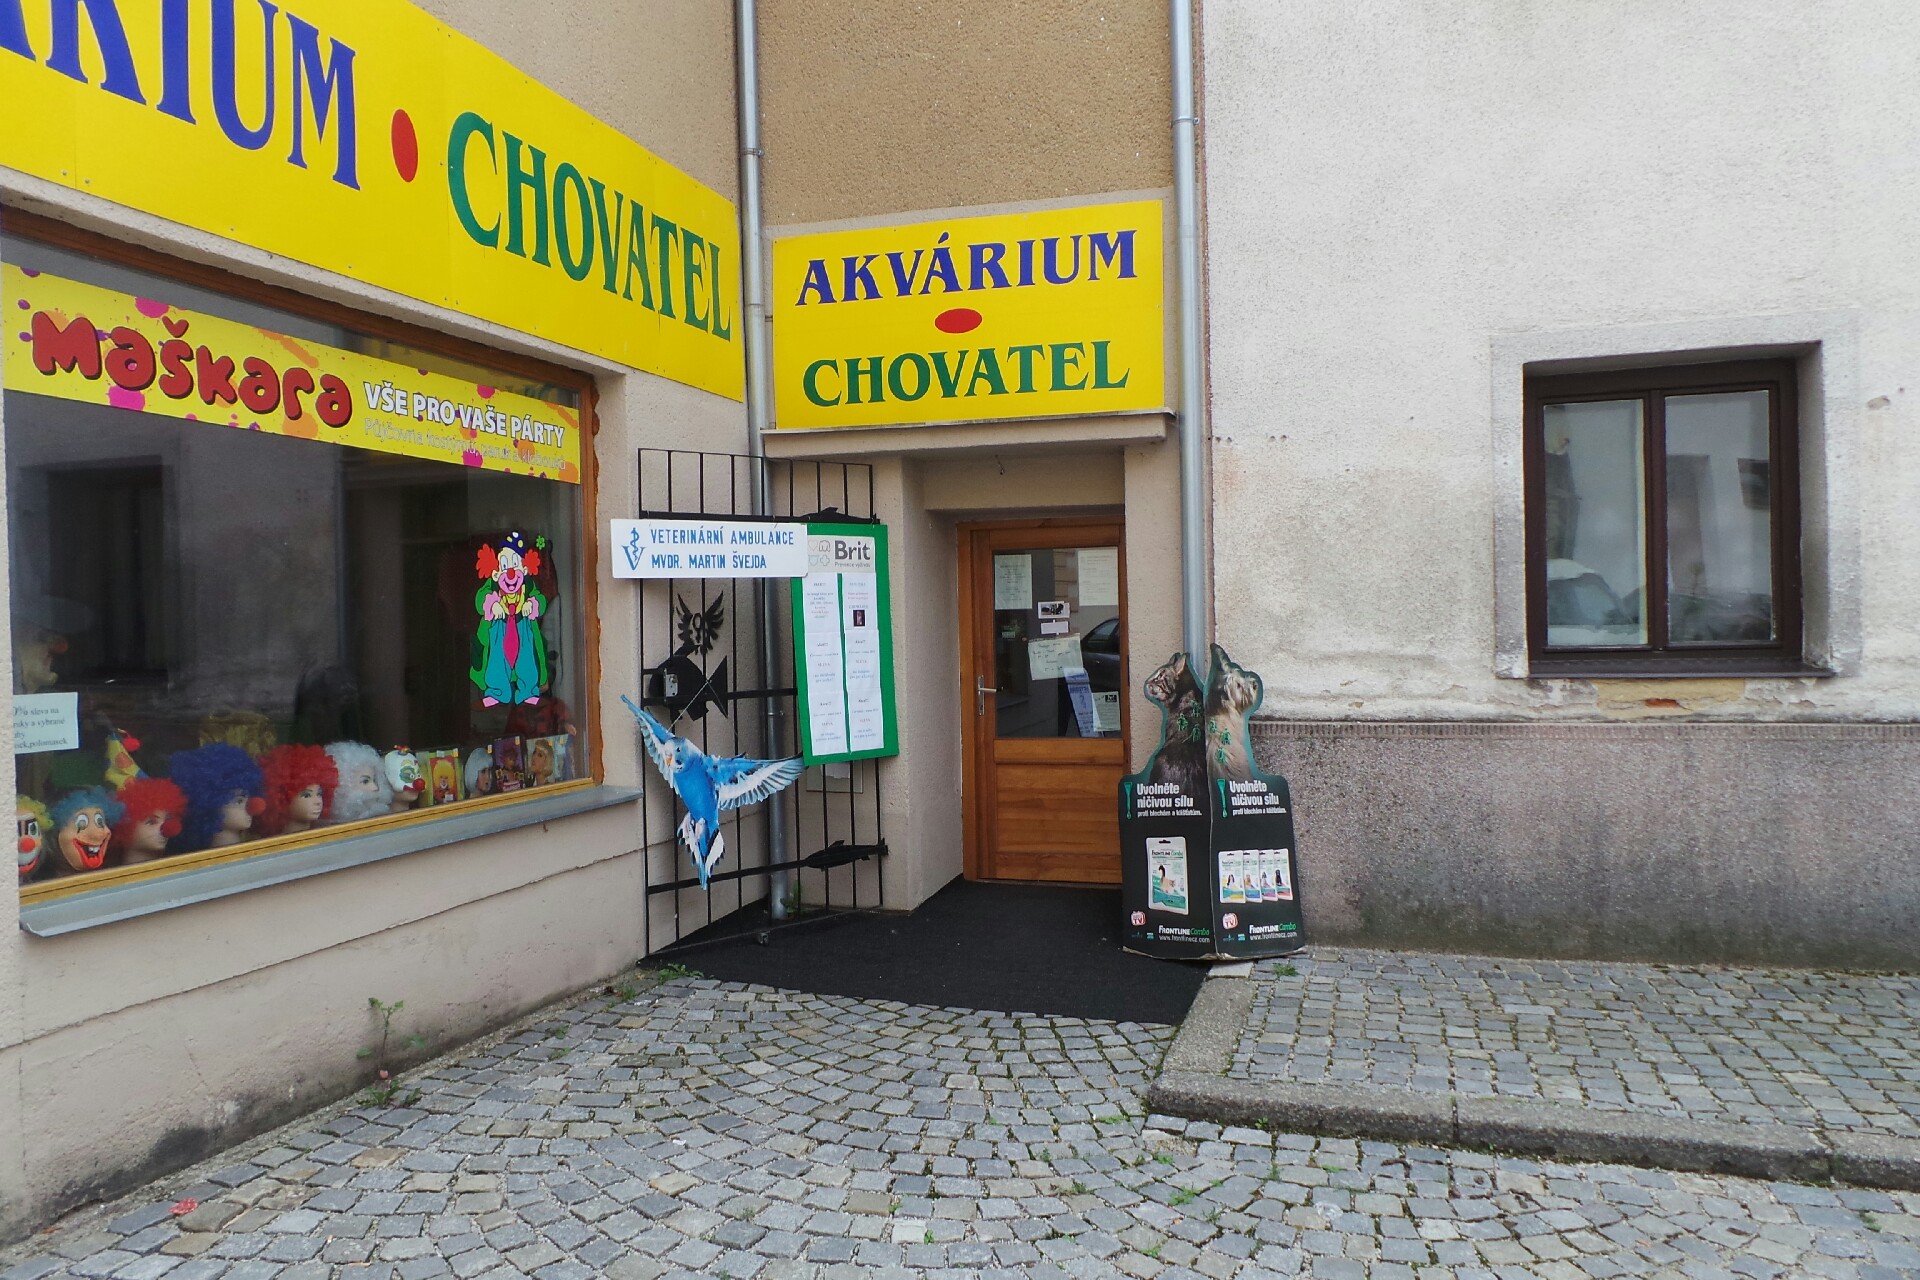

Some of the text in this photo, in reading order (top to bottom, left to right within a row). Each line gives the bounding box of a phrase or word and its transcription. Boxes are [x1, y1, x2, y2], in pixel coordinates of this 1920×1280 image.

[447, 112, 731, 342] CHOVATEL
[795, 230, 1138, 306] AKVÁRIUM
[31, 311, 353, 429] Maškara
[803, 340, 1130, 407] CHOVATEL
[363, 380, 566, 448] VŠE PRO VAŠE PÁRTY
[650, 526, 795, 546] VETERINÁRNÍ AMBULANCE
[834, 540, 871, 560] Brit
[651, 551, 767, 569] MVDR. MARTIN ŠVEJDA
[31, 707, 49, 716] sleva
[38, 717, 66, 727] vybrané
[1137, 782, 1180, 796] Uvolněte
[1230, 779, 1268, 793] Uvolněte
[1137, 794, 1194, 809] ničivou sílu
[1231, 792, 1280, 806] ničivou sílu
[1133, 917, 1143, 925] TV
[1225, 920, 1235, 928] TV
[1249, 922, 1297, 934] FRONTLINE Combo
[1158, 925, 1191, 936] FRONTLINE
[1190, 927, 1210, 936] Combo
